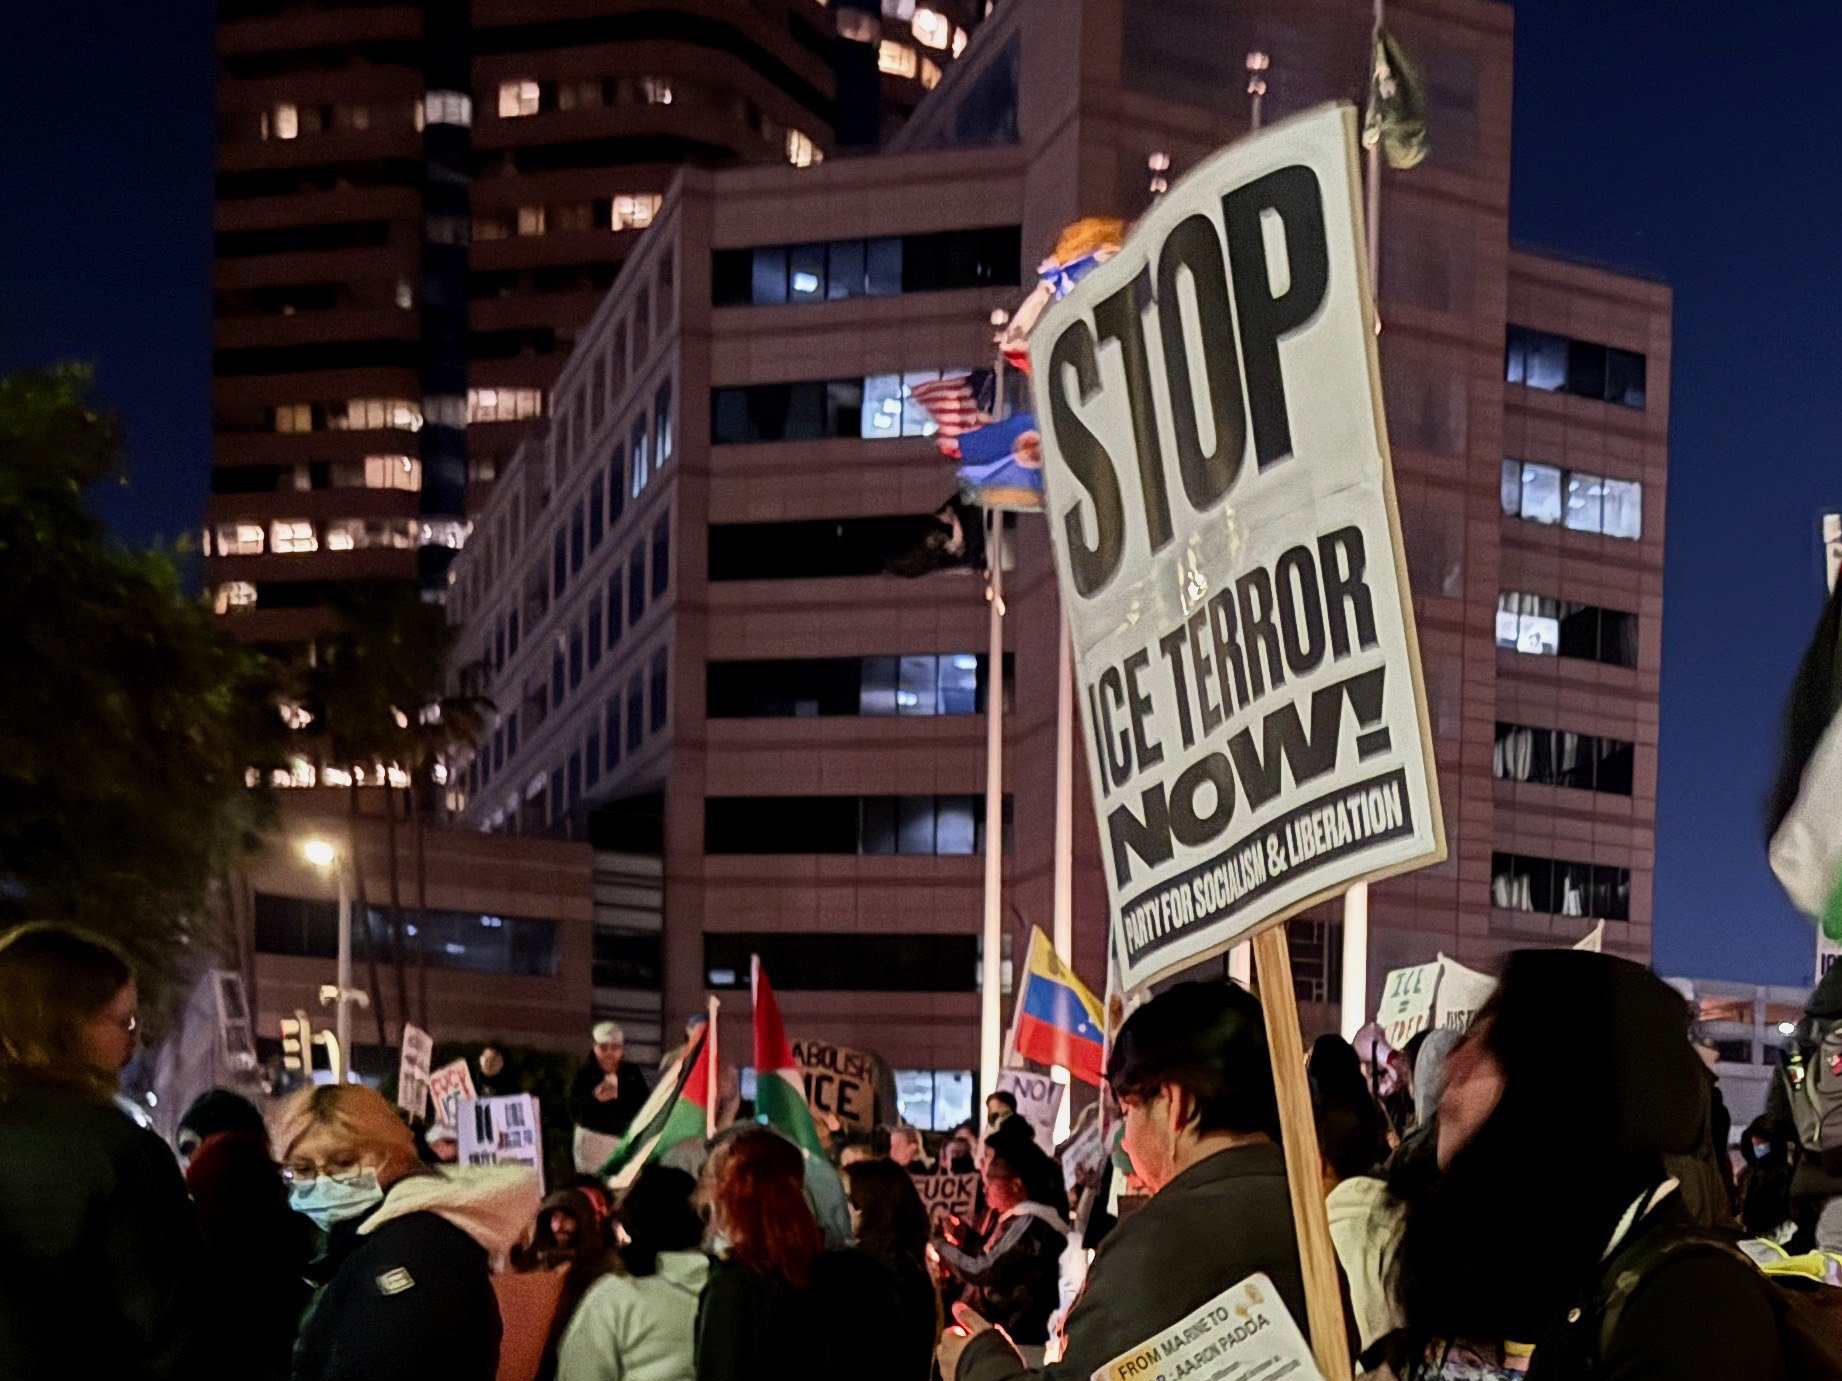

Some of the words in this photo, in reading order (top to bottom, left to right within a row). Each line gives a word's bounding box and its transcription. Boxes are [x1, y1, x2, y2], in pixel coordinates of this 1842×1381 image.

[1048, 164, 1328, 599] STOP
[1088, 647, 1164, 798] ICE
[1160, 525, 1379, 751] TERROR
[1106, 665, 1392, 893] NOW!
[1126, 897, 1162, 955] PARTY
[1161, 884, 1195, 935] FOR
[1194, 848, 1267, 917] SOCIALISM
[1267, 831, 1289, 878] &
[1287, 787, 1403, 867] LIBERATION
[792, 1041, 874, 1085] ABOLISH
[804, 1071, 861, 1122] ICE
[1117, 1347, 1163, 1381] FROM
[1207, 1305, 1230, 1326] TO
[1218, 1312, 1271, 1352] PADDA
